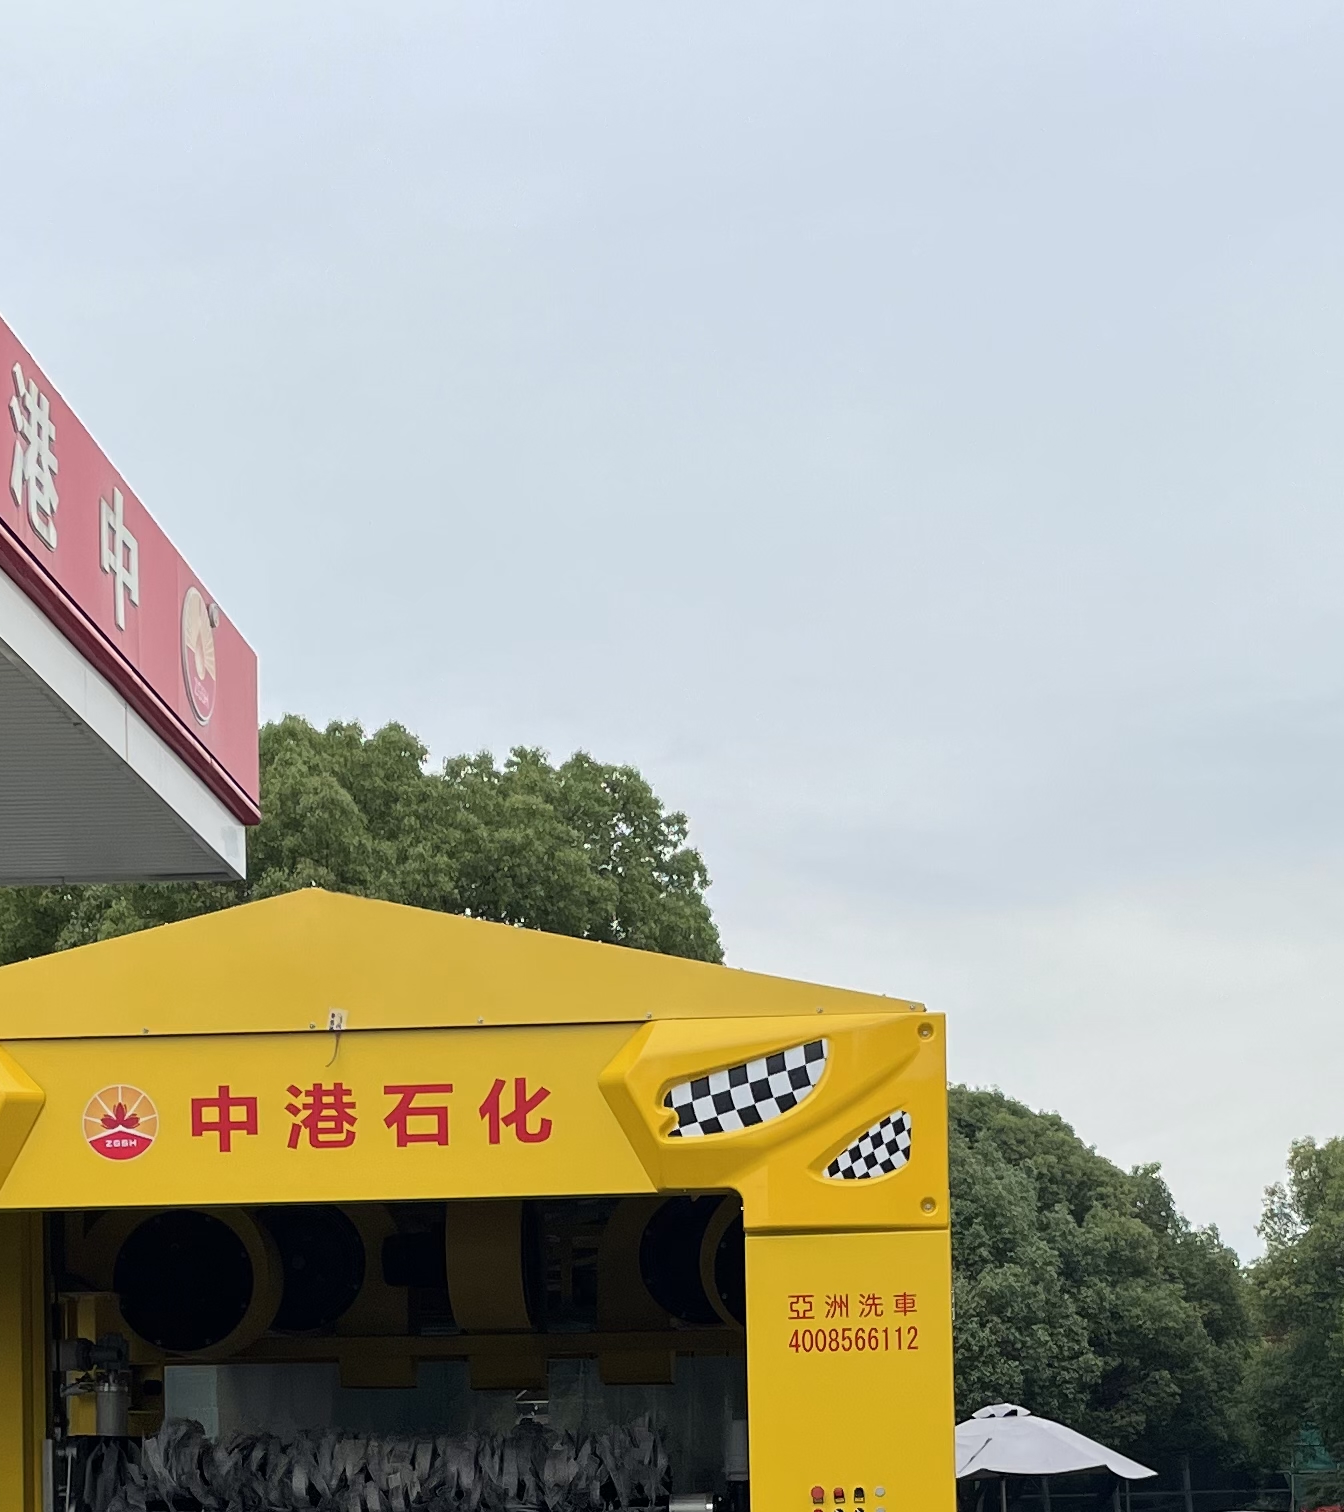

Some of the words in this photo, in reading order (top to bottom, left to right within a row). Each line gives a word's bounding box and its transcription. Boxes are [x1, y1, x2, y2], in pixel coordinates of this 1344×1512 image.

[190, 1077, 553, 1153] 中港石化
[787, 1292, 918, 1320] 亞洲洗車
[788, 1325, 919, 1353] 4008566112
